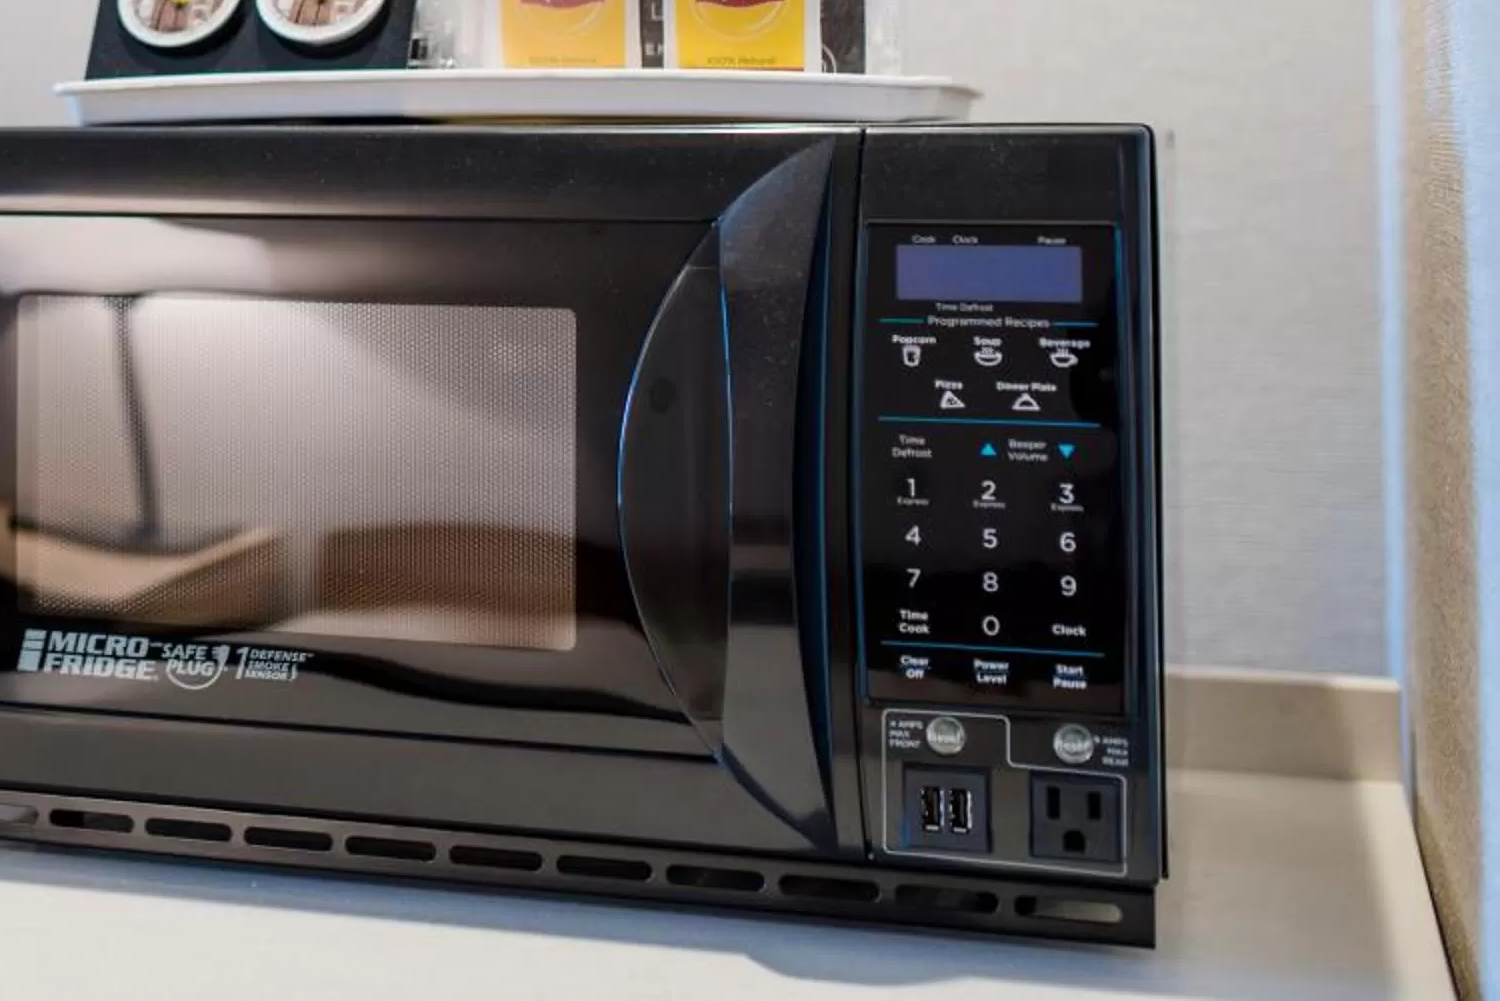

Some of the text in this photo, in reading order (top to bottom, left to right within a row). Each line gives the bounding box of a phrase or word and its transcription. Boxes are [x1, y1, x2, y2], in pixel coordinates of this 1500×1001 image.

[927, 314, 1050, 330] Programmed Recipes
[899, 435, 926, 446] Time
[891, 446, 932, 459] Defrost
[1007, 450, 1049, 463] Volume
[906, 477, 917, 498] 1
[980, 480, 997, 501] 2
[1058, 483, 1076, 504] 3
[904, 524, 922, 546] 4
[982, 528, 999, 549] 5
[1059, 531, 1077, 552] 6
[906, 567, 921, 588] 7
[982, 571, 1000, 592] 8
[1059, 575, 1077, 597] 9
[899, 609, 929, 622] Time
[898, 622, 931, 635] Cook
[1051, 623, 1087, 638] Clock
[48, 630, 149, 657] MICRO
[161, 642, 206, 661] SAFE
[249, 648, 307, 662] DEFENSE
[900, 655, 930, 668] Clear
[42, 652, 153, 680] FRIDGE
[166, 658, 216, 677] PLUG
[247, 659, 290, 672] SMOKE
[905, 667, 925, 680] Off
[972, 658, 1010, 673] Power
[1055, 662, 1085, 677] Start
[975, 672, 1007, 686] Level
[1052, 675, 1088, 691] Pause
